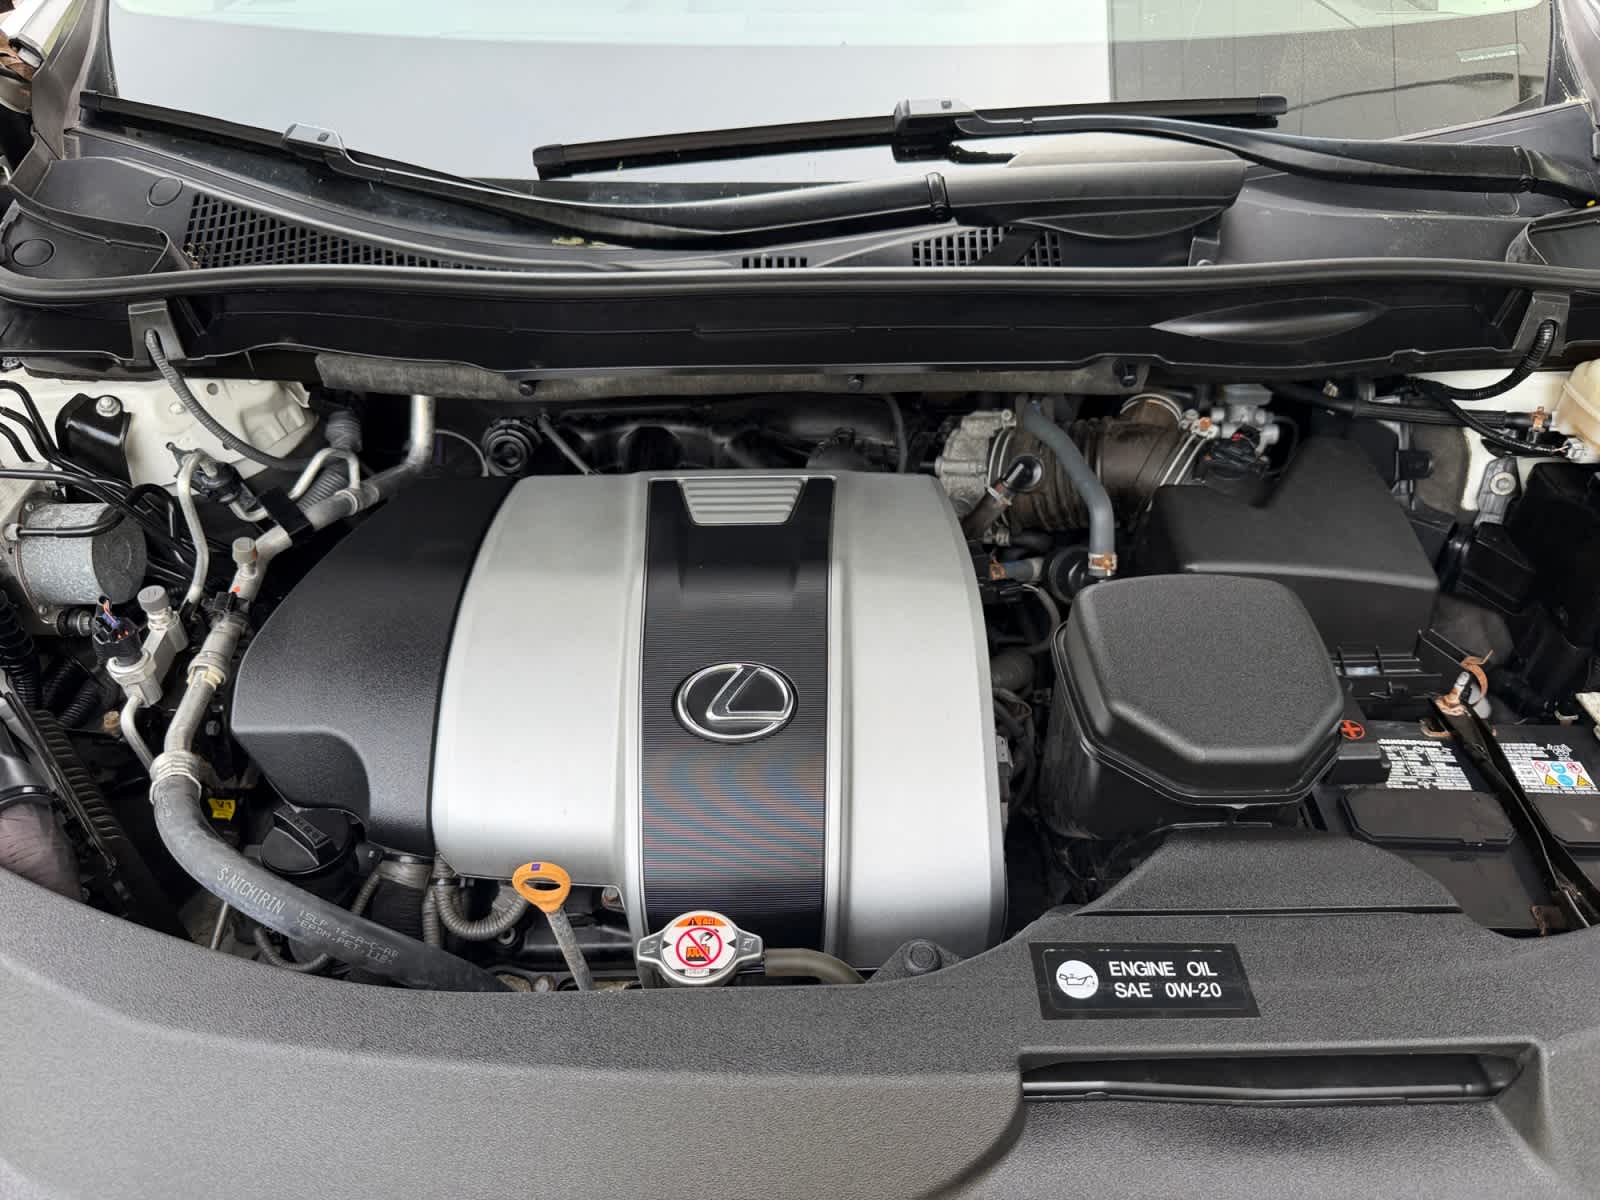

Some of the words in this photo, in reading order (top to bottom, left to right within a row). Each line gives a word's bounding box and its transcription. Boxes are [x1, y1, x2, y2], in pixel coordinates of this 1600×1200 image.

[1109, 961, 1176, 976] ENGINE
[1187, 962, 1217, 976] OIL
[1114, 982, 1152, 998] SAE
[1165, 982, 1221, 998] 0W-20
